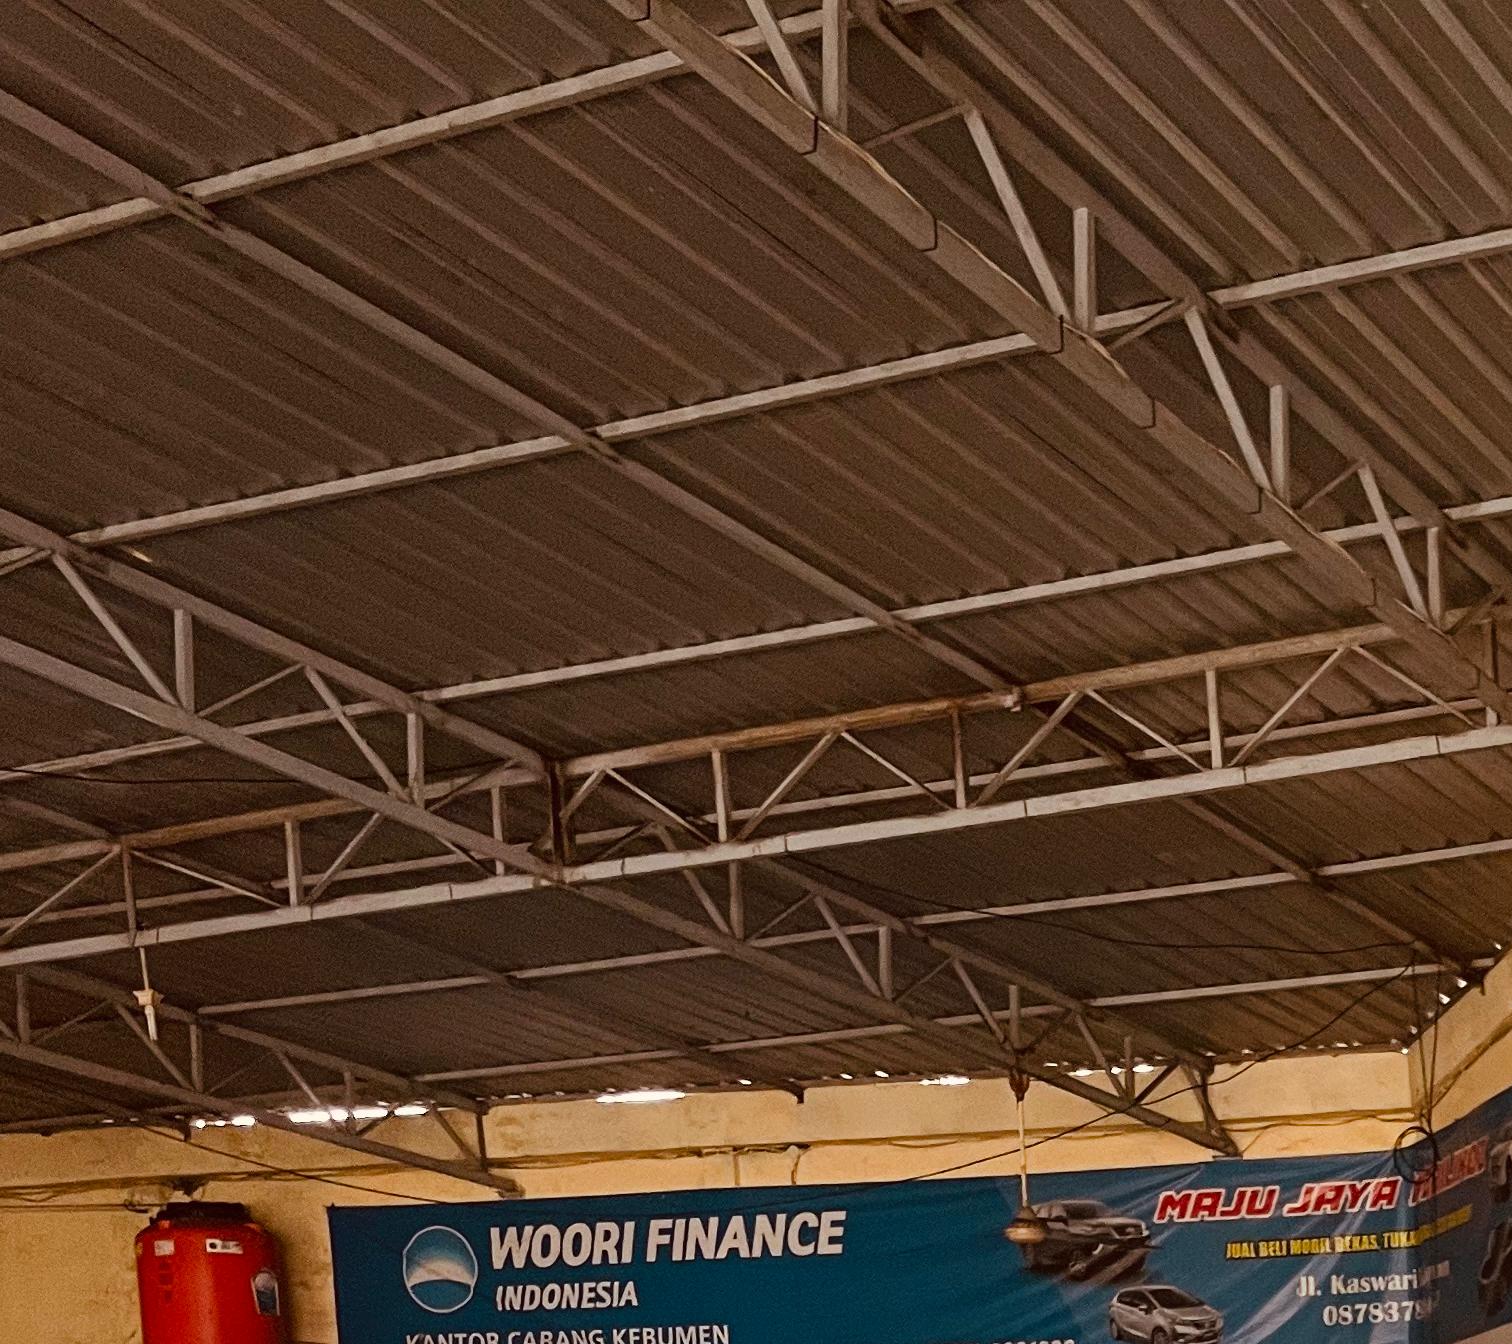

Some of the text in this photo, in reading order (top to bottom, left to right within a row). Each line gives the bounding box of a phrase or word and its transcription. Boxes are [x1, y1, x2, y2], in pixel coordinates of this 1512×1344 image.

[1153, 1176, 1403, 1222] MAJU JAYA
[489, 1209, 848, 1270] WOORI FINANCE
[495, 1281, 639, 1312] INDONESIA
[1330, 1268, 1419, 1296] Kaswari
